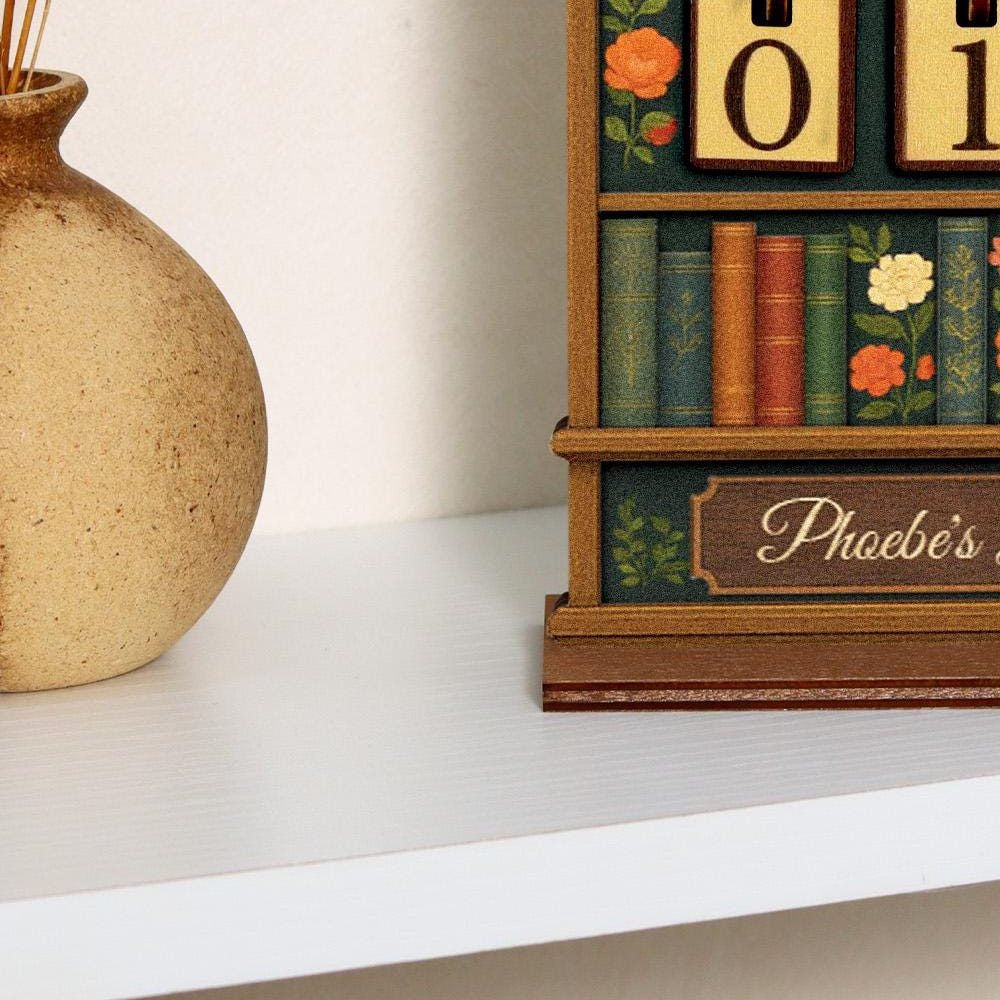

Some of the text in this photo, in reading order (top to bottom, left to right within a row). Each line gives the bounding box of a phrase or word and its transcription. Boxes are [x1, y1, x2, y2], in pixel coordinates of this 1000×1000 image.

[724, 38, 811, 151] 0
[951, 39, 1000, 151] 1
[757, 497, 984, 563] Phoebe's
